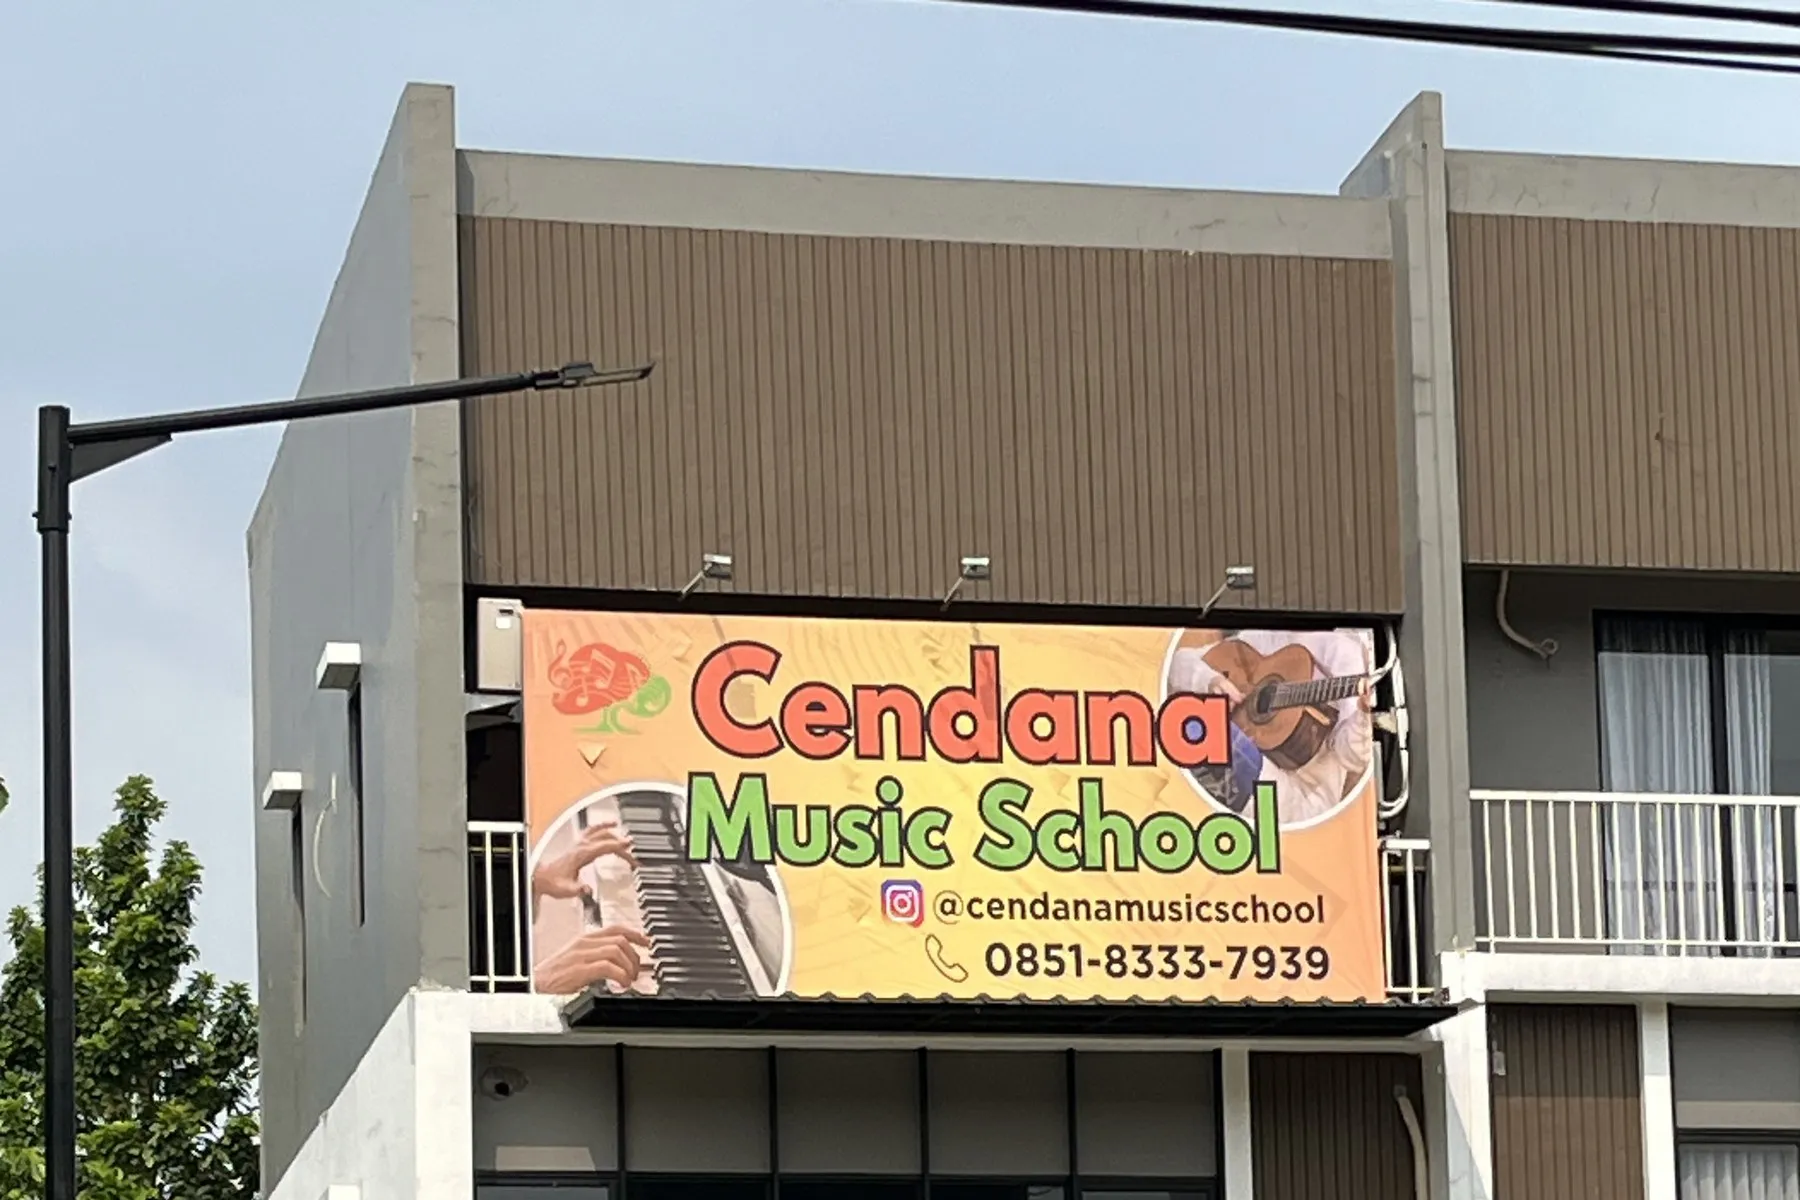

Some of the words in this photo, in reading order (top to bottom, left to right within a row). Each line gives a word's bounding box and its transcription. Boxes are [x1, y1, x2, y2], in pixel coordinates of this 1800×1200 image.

[690, 640, 1233, 766] Cendana
[687, 772, 955, 871] Music
[974, 779, 1281, 875] School
[933, 889, 1325, 926] @cendanamusicschool
[985, 943, 1331, 981] 0851-8333-7939
